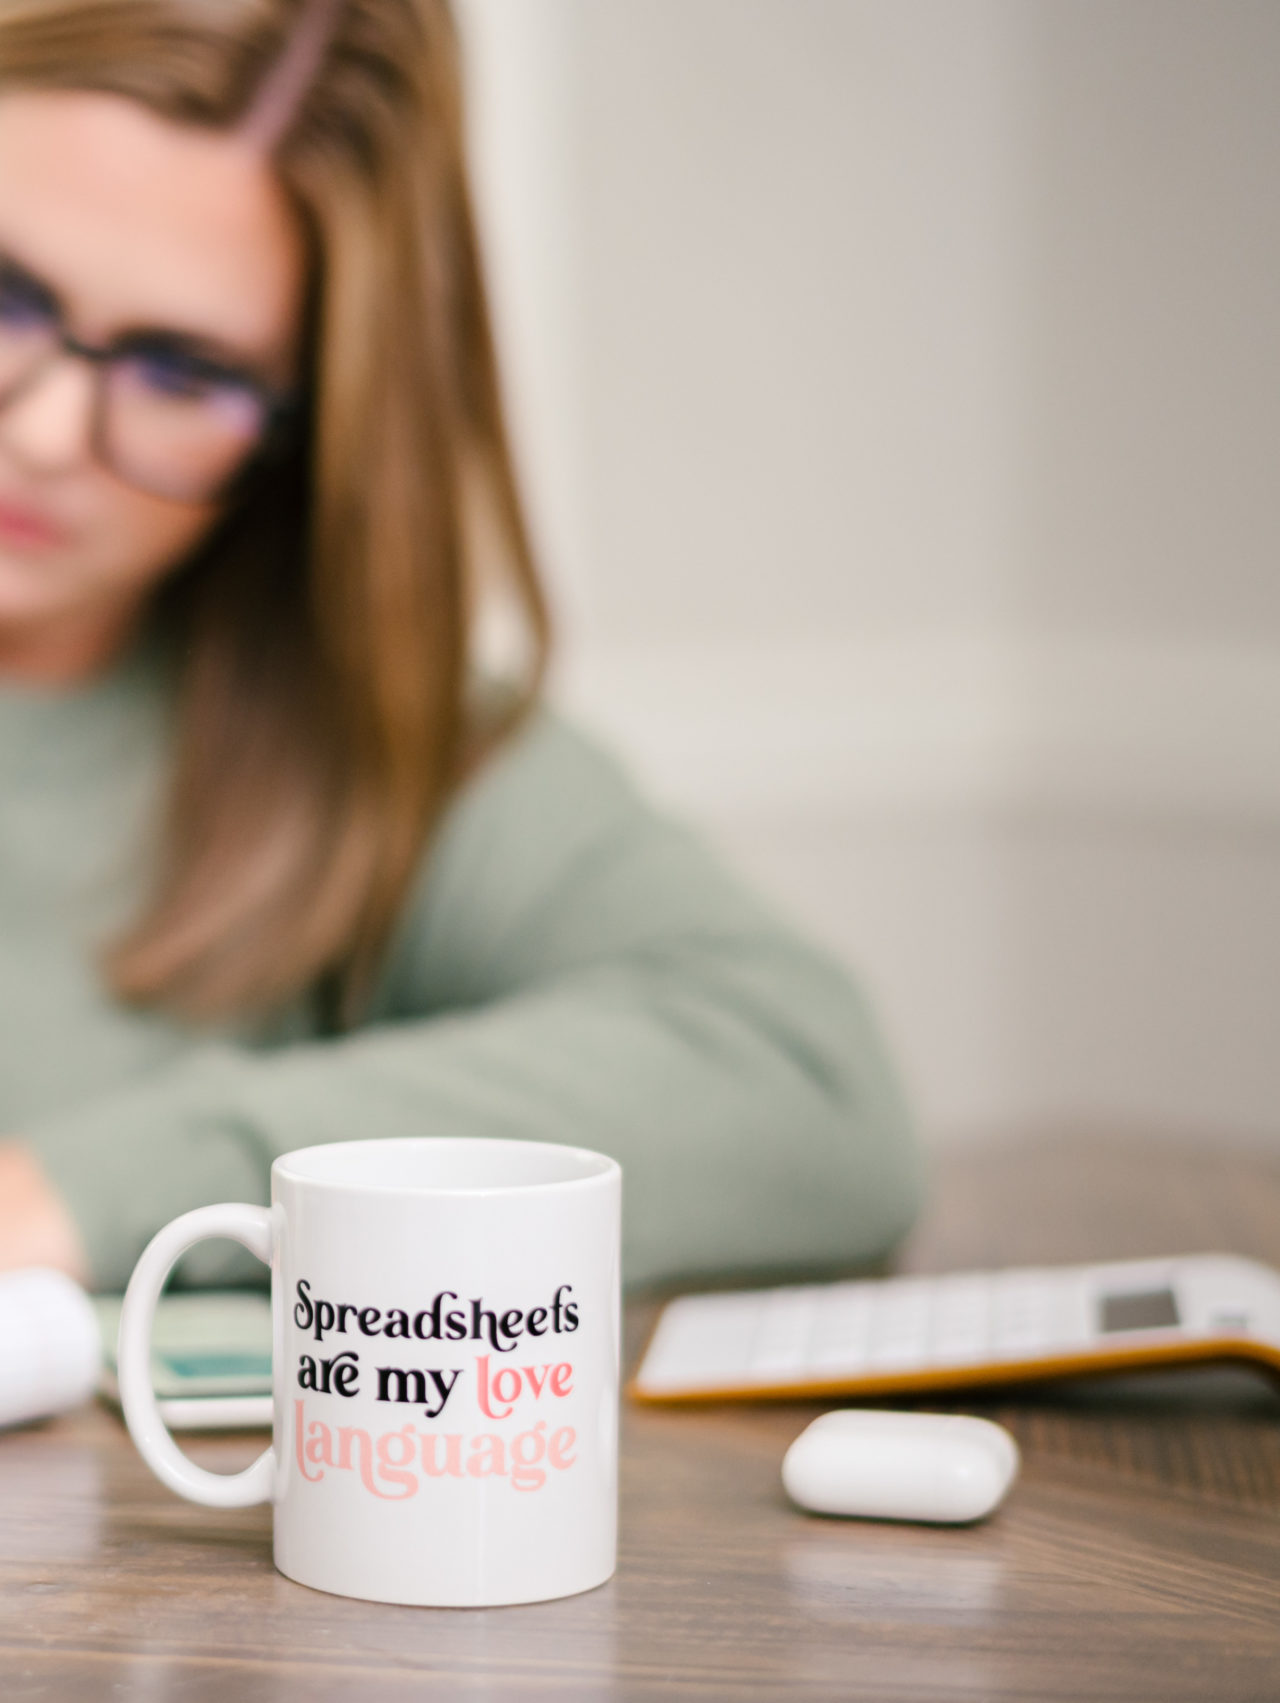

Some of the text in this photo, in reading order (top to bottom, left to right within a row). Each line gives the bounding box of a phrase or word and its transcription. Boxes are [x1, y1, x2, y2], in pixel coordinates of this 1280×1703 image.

[294, 1279, 579, 1352] Spreadsheets
[297, 1351, 574, 1419] are my love
[294, 1399, 577, 1500] language
